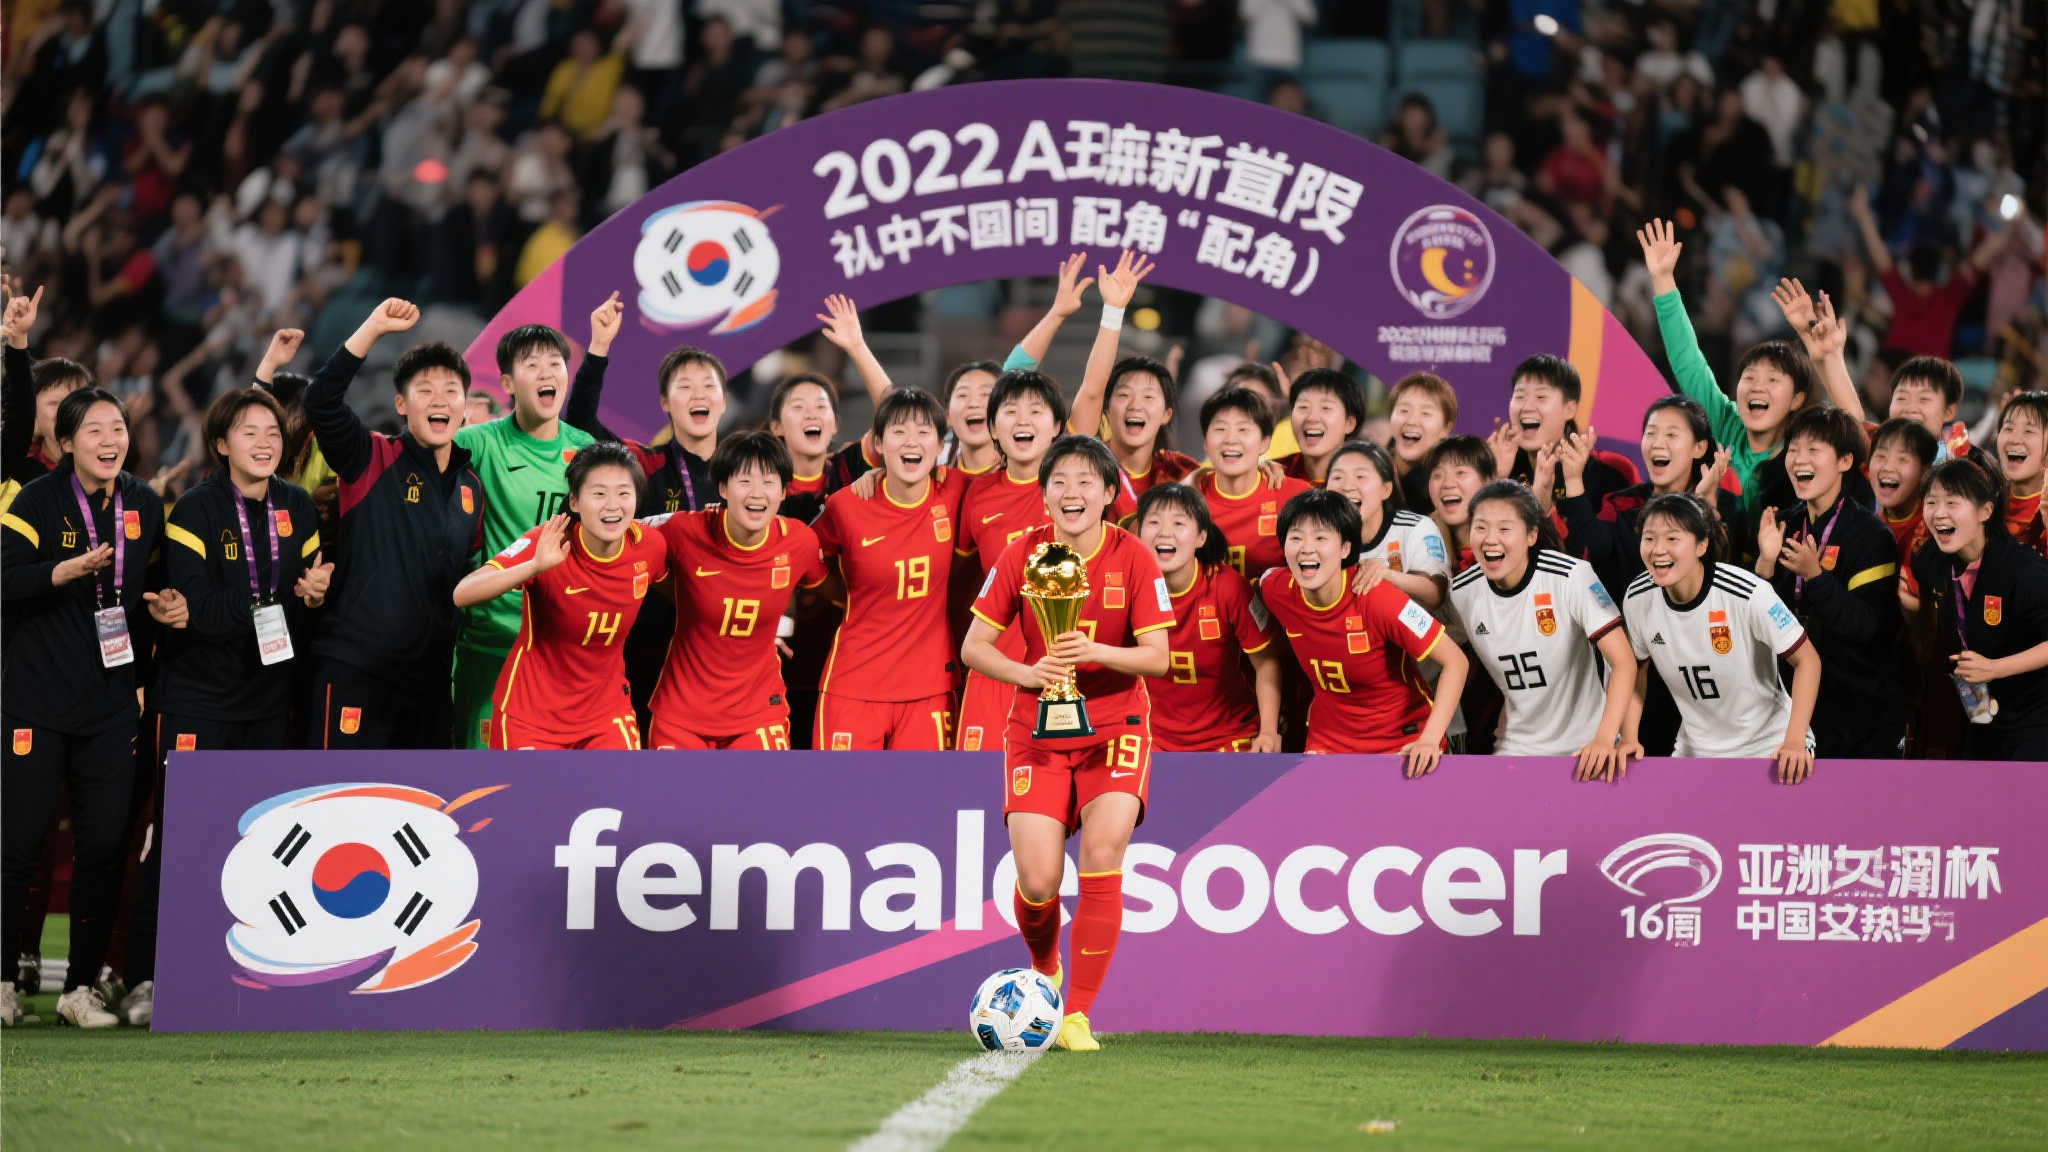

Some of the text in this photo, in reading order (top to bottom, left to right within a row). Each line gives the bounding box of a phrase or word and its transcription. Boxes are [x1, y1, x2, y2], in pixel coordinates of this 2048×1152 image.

[894, 555, 930, 601] 19
[581, 611, 622, 646] 14
[719, 597, 761, 637] 19
[1309, 658, 1351, 694] 13
[1678, 665, 1720, 700] 16
[1106, 734, 1141, 769] 19
